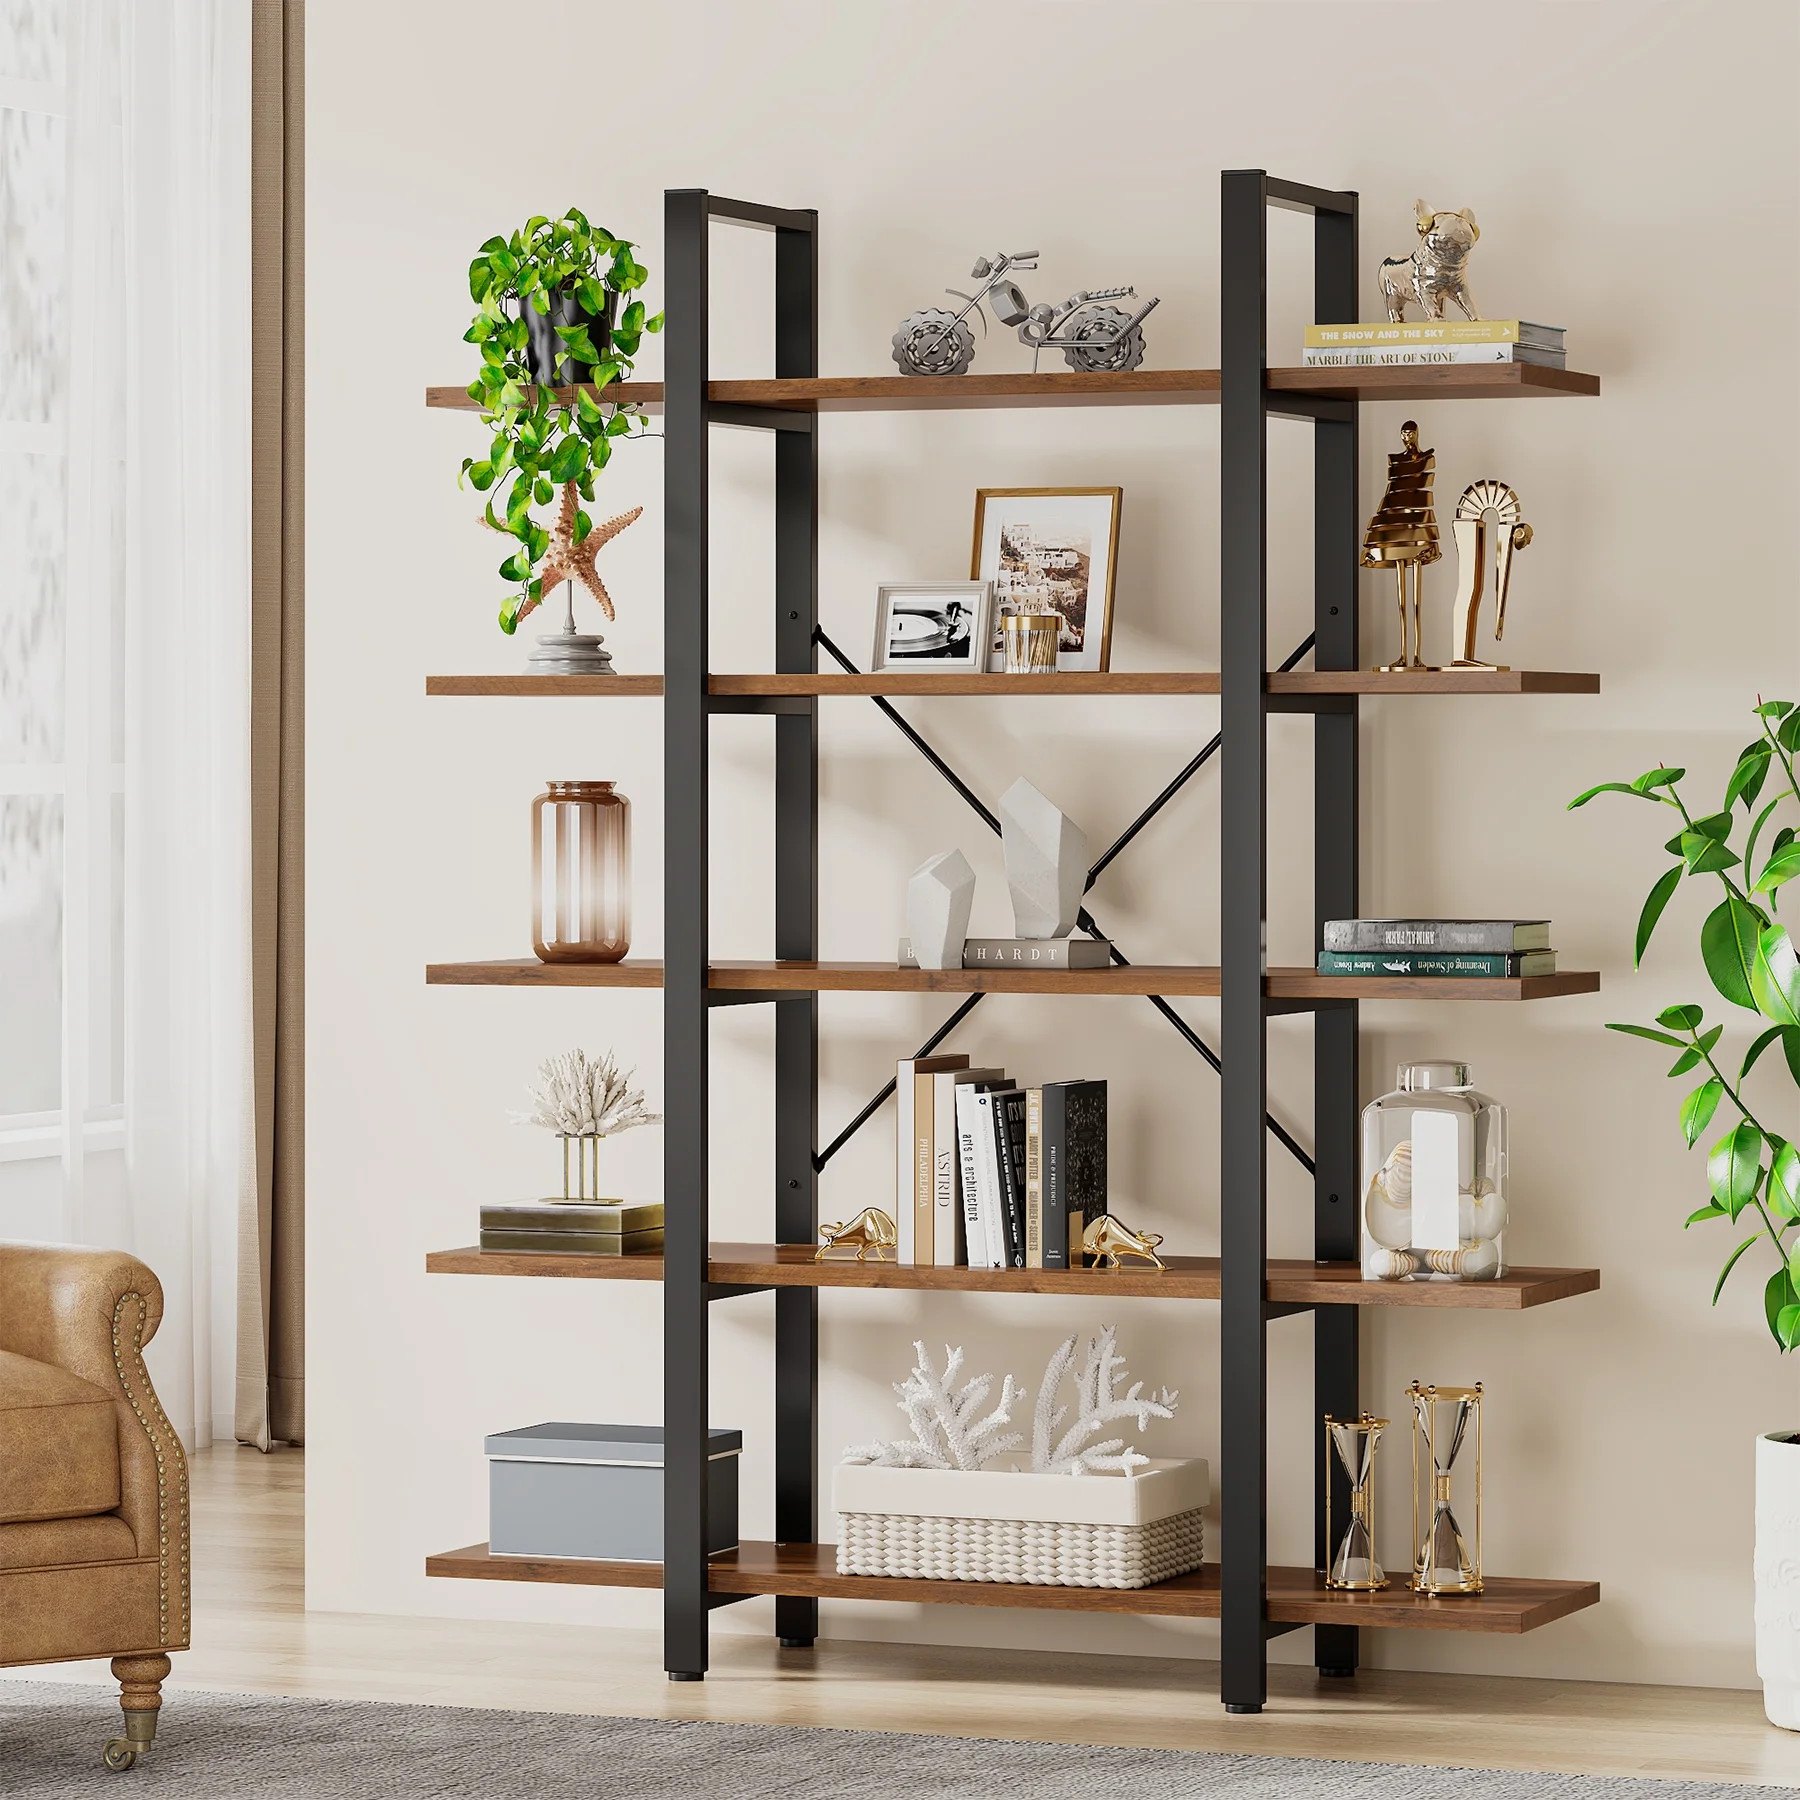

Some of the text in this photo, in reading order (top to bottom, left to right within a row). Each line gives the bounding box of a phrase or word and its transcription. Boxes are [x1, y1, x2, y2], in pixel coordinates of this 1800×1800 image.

[1321, 331, 1339, 340] THE
[1342, 331, 1374, 340] SNOW
[1377, 330, 1400, 339] AND
[1403, 329, 1421, 338] THE
[1424, 329, 1445, 338] SKY
[1307, 351, 1456, 366] MARBLE THE ART OF STONE
[1385, 931, 1405, 944] FARM
[1406, 931, 1435, 945] ANIMAL
[907, 947, 1058, 961] BNHARDT
[1333, 961, 1376, 972] Andrew Brown
[1417, 957, 1491, 973] Dreaming of Sweden
[962, 1134, 974, 1152] arts
[1029, 1136, 1039, 1156] HARRY
[919, 1138, 929, 1208] PHILADELPHIA
[938, 1147, 950, 1207] ASTRID
[1029, 1157, 1039, 1180] POTTER
[964, 1166, 979, 1222] architecture
[1029, 1191, 1039, 1220] CHAMBER
[1029, 1225, 1039, 1251] SECRETS
